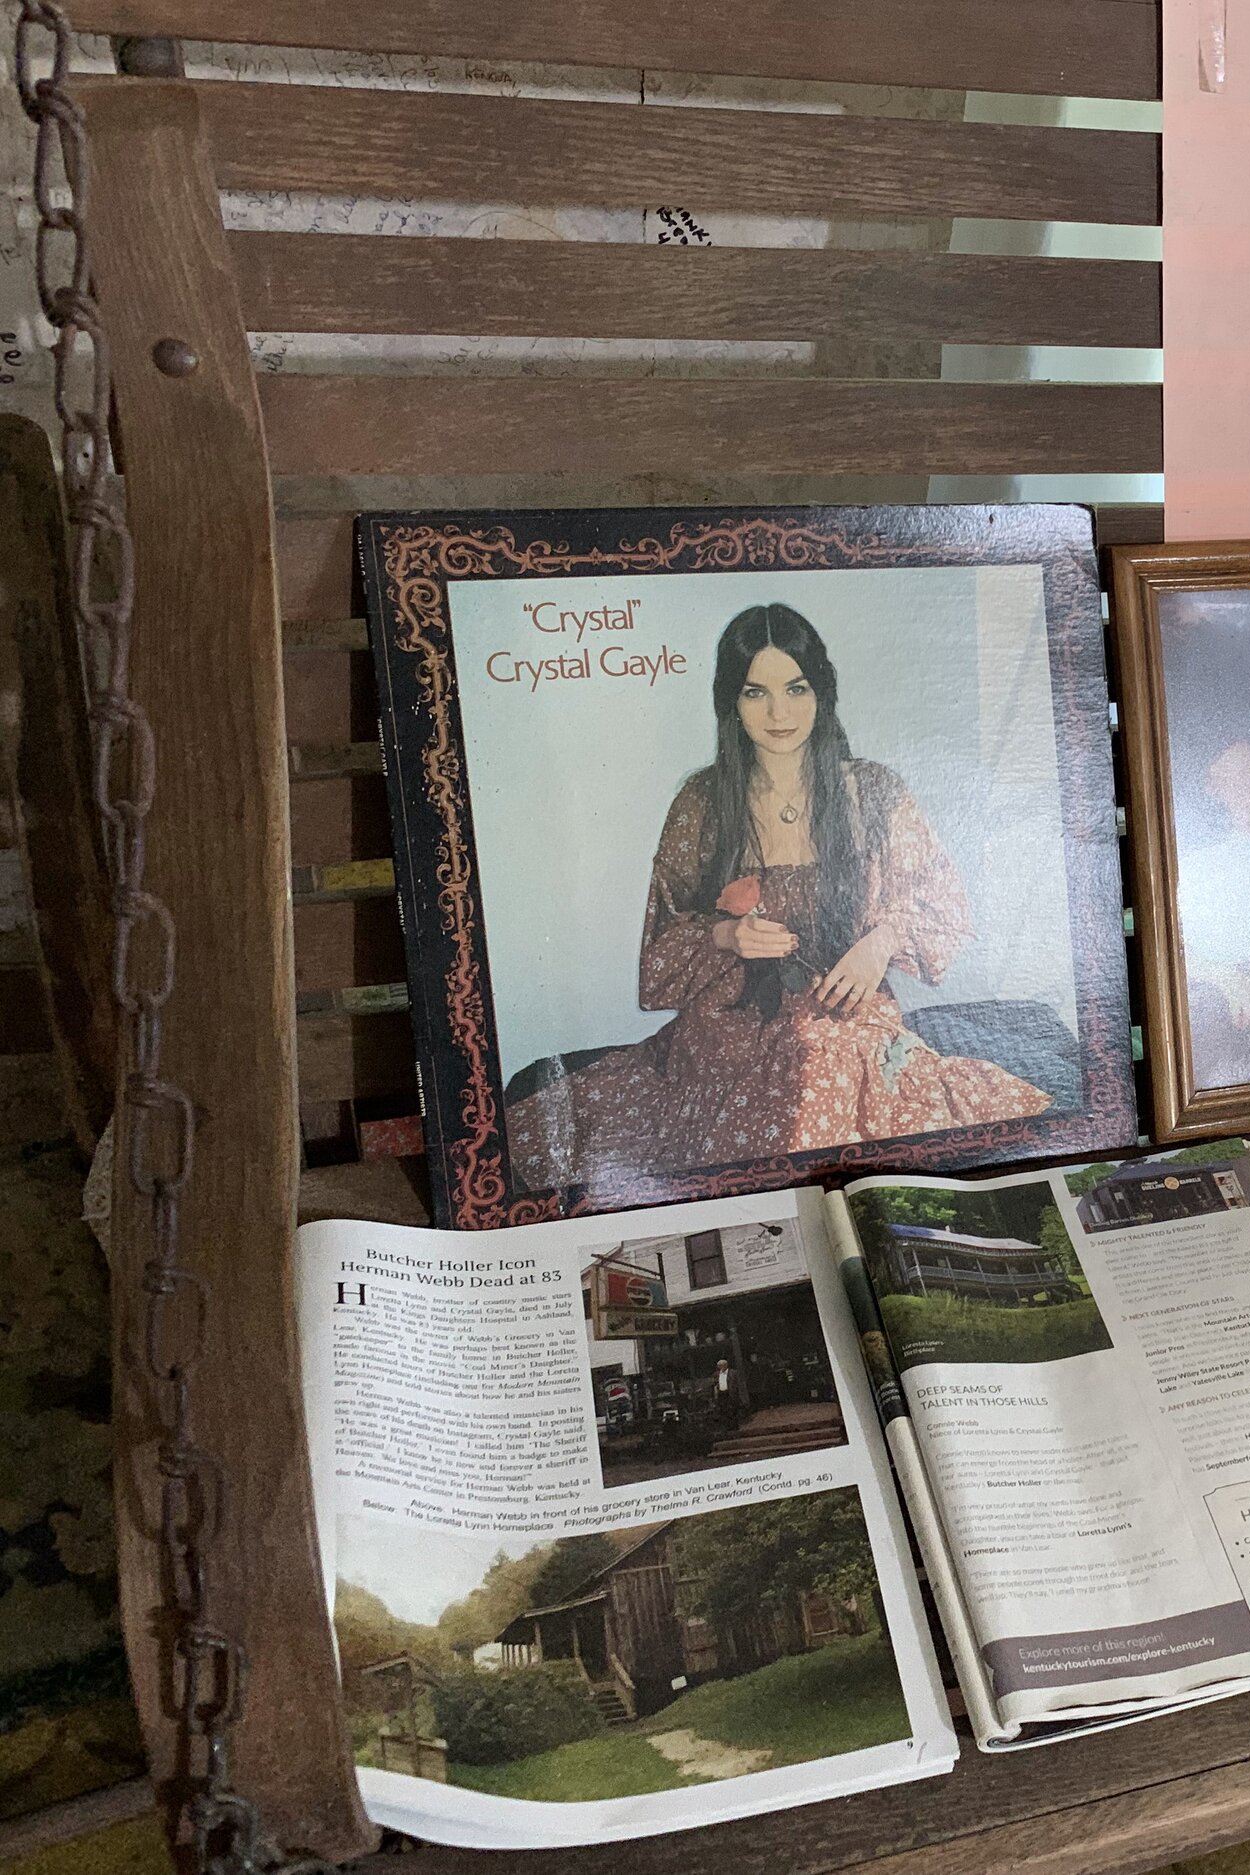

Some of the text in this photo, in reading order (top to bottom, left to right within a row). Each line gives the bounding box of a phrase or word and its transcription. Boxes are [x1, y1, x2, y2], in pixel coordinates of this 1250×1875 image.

[486, 644, 688, 693] Crystal Gayle
[366, 1248, 536, 1272] Butcher Holler Icon
[339, 1260, 563, 1288] Herman Webb Dead at 83
[1203, 1315, 1237, 1327] Mountain
[1145, 1348, 1167, 1358] Junior
[1156, 1374, 1178, 1385] Jenny
[1200, 1365, 1219, 1375] State
[1220, 1361, 1244, 1371] Resort
[1159, 1370, 1245, 1394] Lake Yatesville Lake
[916, 1384, 1003, 1399] DEEP SEAMS OF
[1166, 1402, 1185, 1413] ANY
[1186, 1396, 1218, 1408] REASON
[1218, 1392, 1231, 1400] TO
[920, 1396, 1049, 1411] TALENT IN THOSE HILLS
[957, 1419, 979, 1427] Webb
[986, 1479, 1042, 1488] Butcher Holler
[405, 1507, 424, 1520] The
[464, 1519, 490, 1531] Lynn
[563, 1510, 632, 1530] Photographs
[633, 1507, 649, 1520] by
[650, 1498, 690, 1514] Thelma
[706, 1486, 754, 1503] Crawford
[816, 1472, 834, 1484] 46)
[451, 1506, 493, 1520] Herman
[495, 1511, 528, 1521] Webb
[530, 1510, 540, 1519] in
[542, 1508, 567, 1519] front
[570, 1505, 581, 1516] of
[583, 1504, 599, 1514] his
[601, 1497, 641, 1515] grocery
[643, 1492, 671, 1504] store
[672, 1489, 683, 1498] in
[684, 1485, 706, 1497] Van
[1077, 1528, 1106, 1538] Loretta
[963, 1545, 1010, 1559] Homeplace
[1018, 1631, 1165, 1661] Explore more of this region!
[1022, 1635, 1216, 1674] kentuckytourism.com/explore-kentucky
